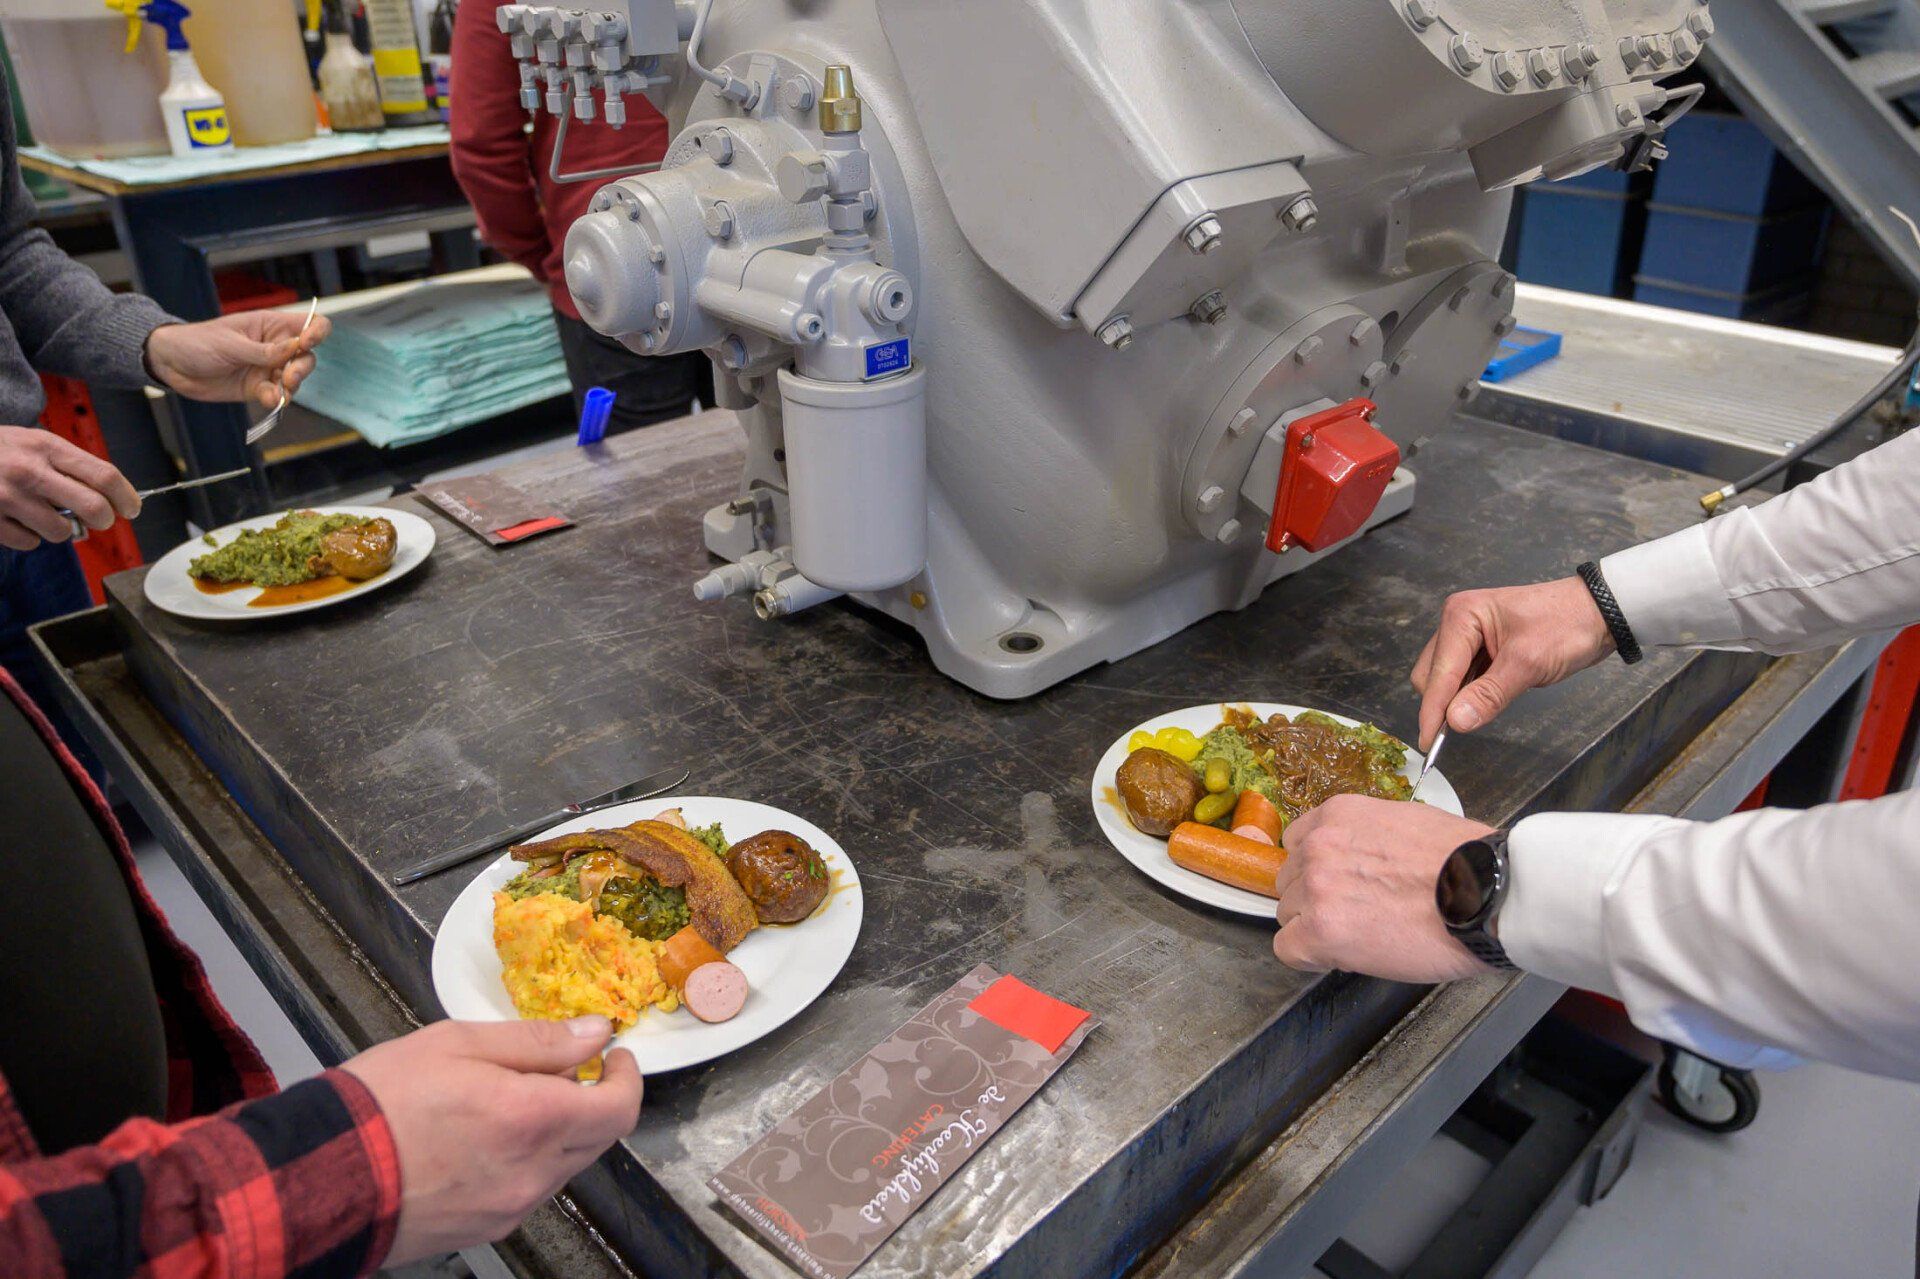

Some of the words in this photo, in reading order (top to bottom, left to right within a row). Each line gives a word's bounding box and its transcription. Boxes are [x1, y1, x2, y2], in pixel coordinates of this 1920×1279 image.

[978, 1084, 1006, 1108] de
[859, 1106, 989, 1225] Heerlijkheid
[871, 1103, 945, 1170] CATERING
